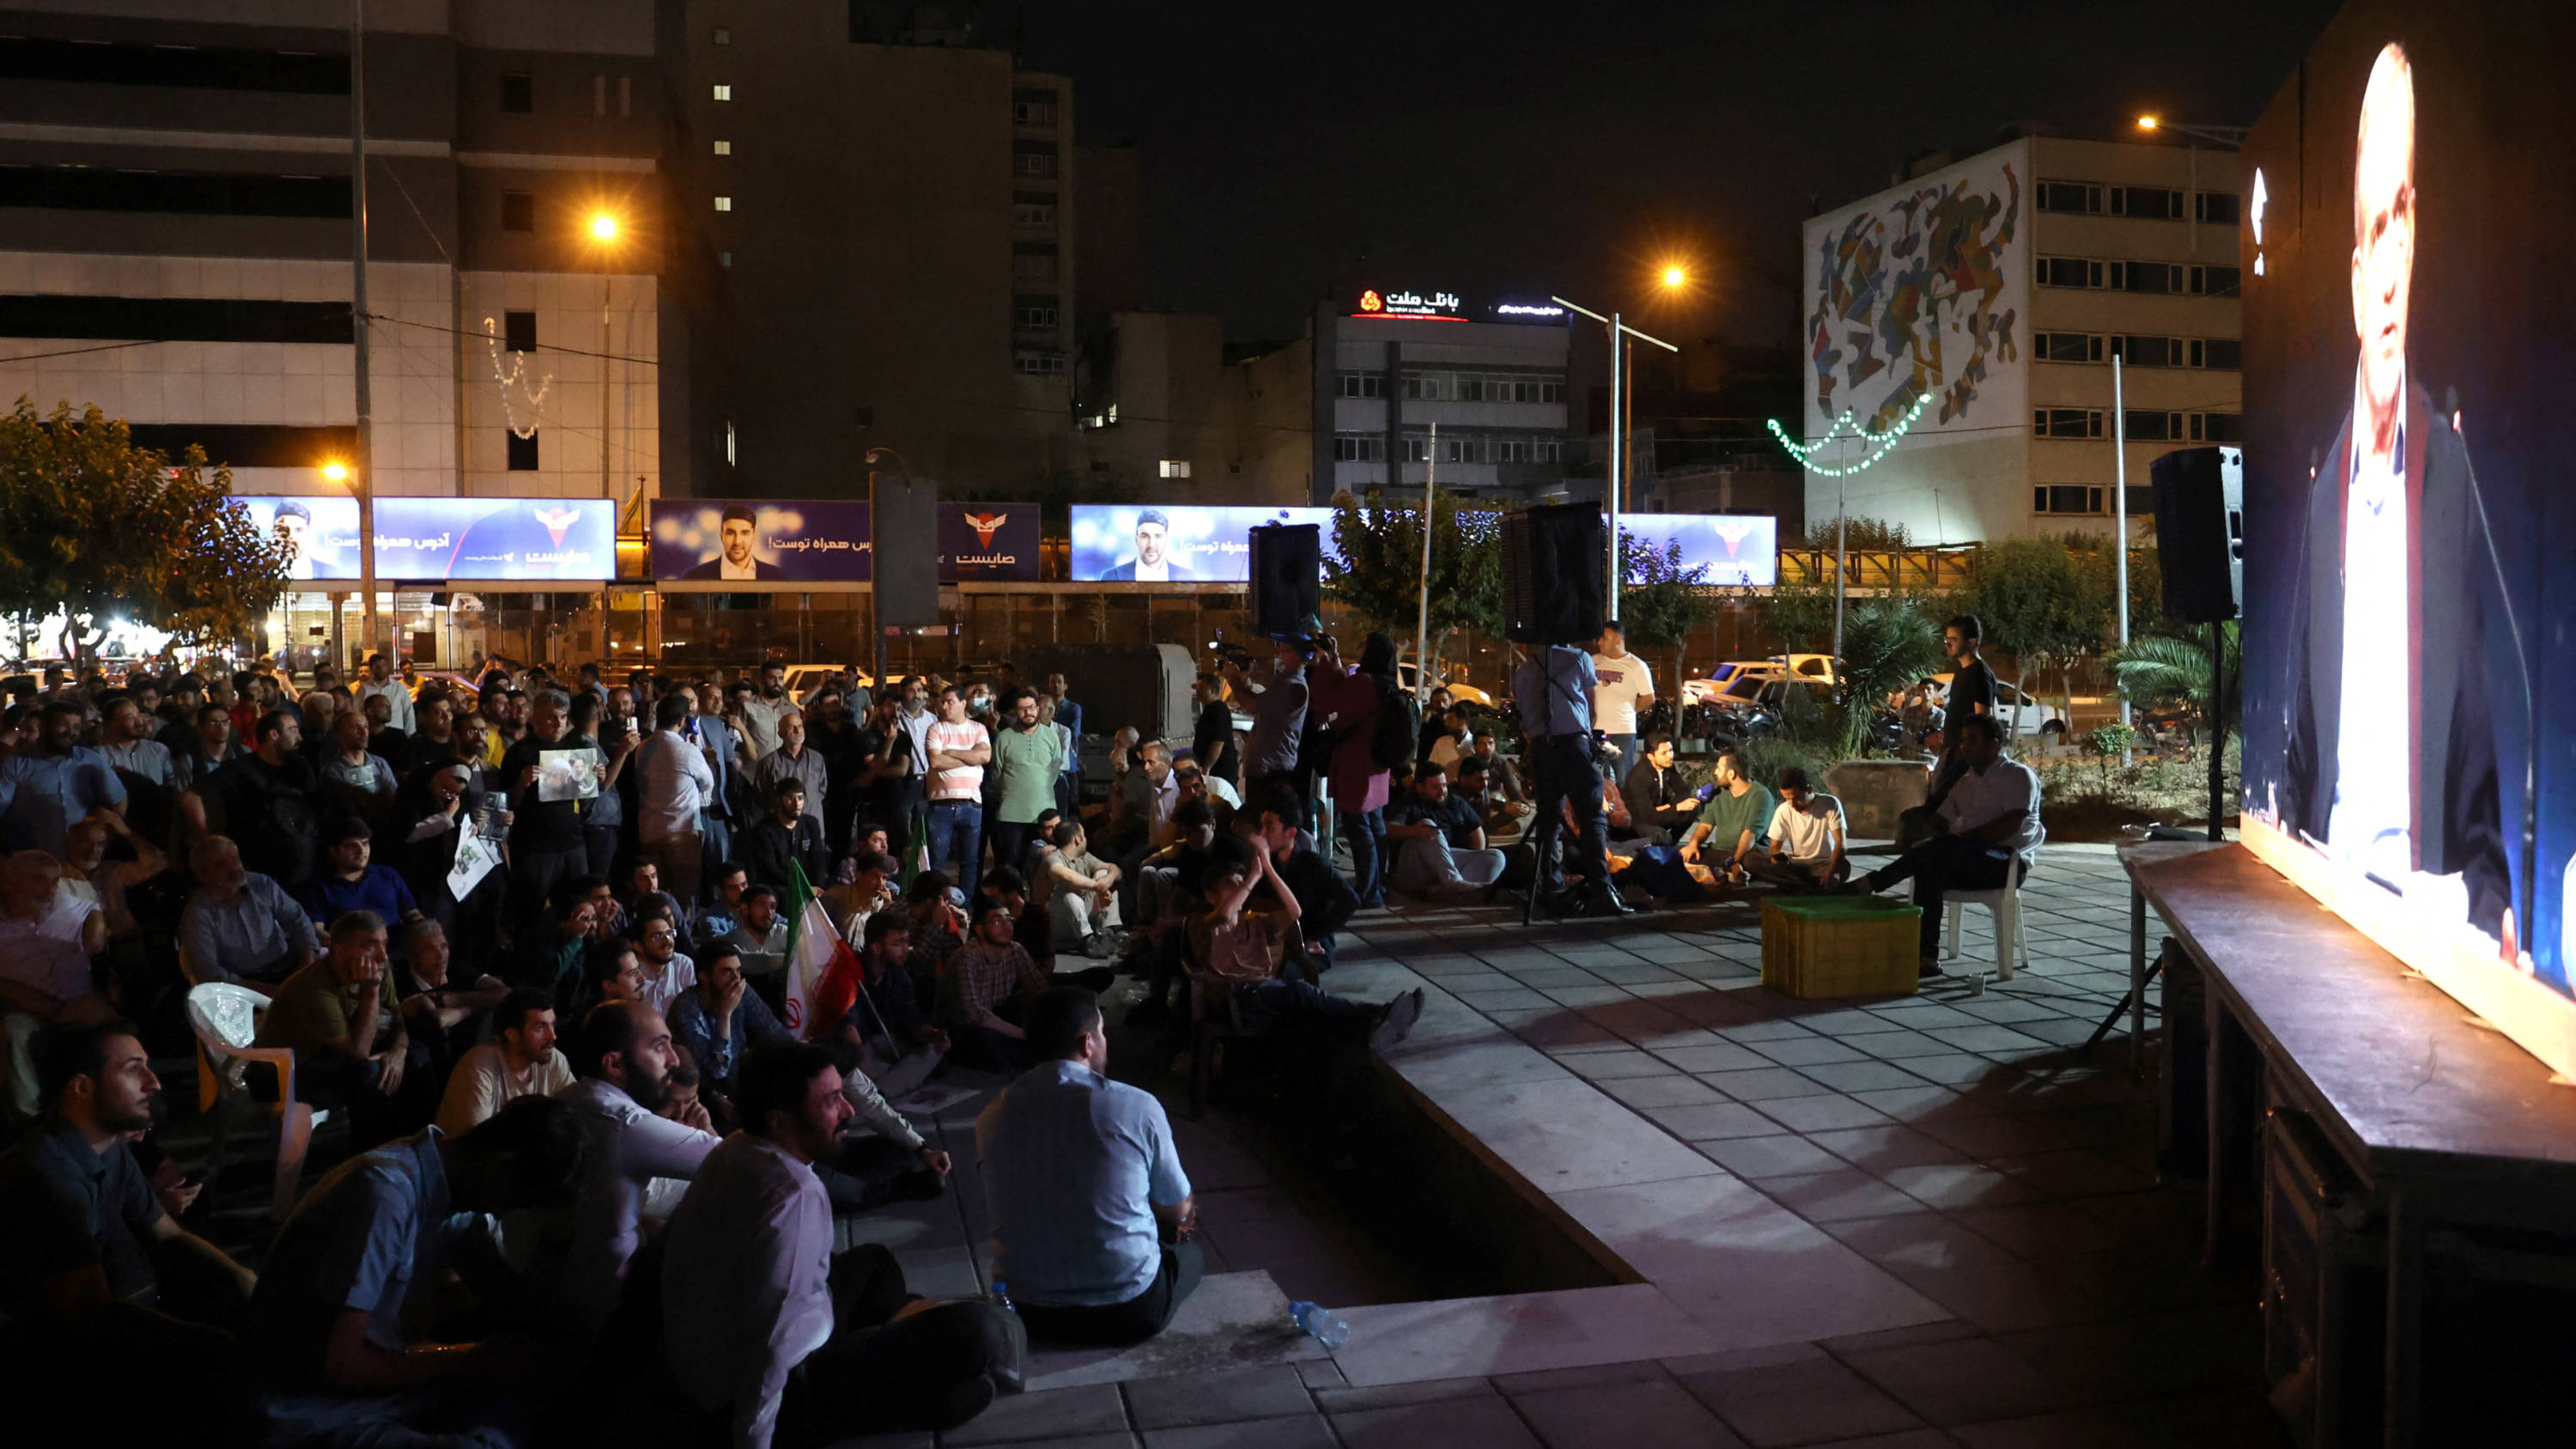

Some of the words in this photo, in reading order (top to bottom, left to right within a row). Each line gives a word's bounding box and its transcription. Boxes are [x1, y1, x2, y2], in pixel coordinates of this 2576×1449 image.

[1386, 290, 1422, 306] ملت
[1424, 291, 1459, 313] بانک
[324, 533, 361, 551] وست!
[373, 533, 412, 551] همراه
[414, 533, 451, 551] آدرس
[769, 536, 811, 552] توست!
[812, 537, 849, 553] همراه
[1180, 540, 1219, 556] توست!
[956, 551, 1016, 569] صایست
